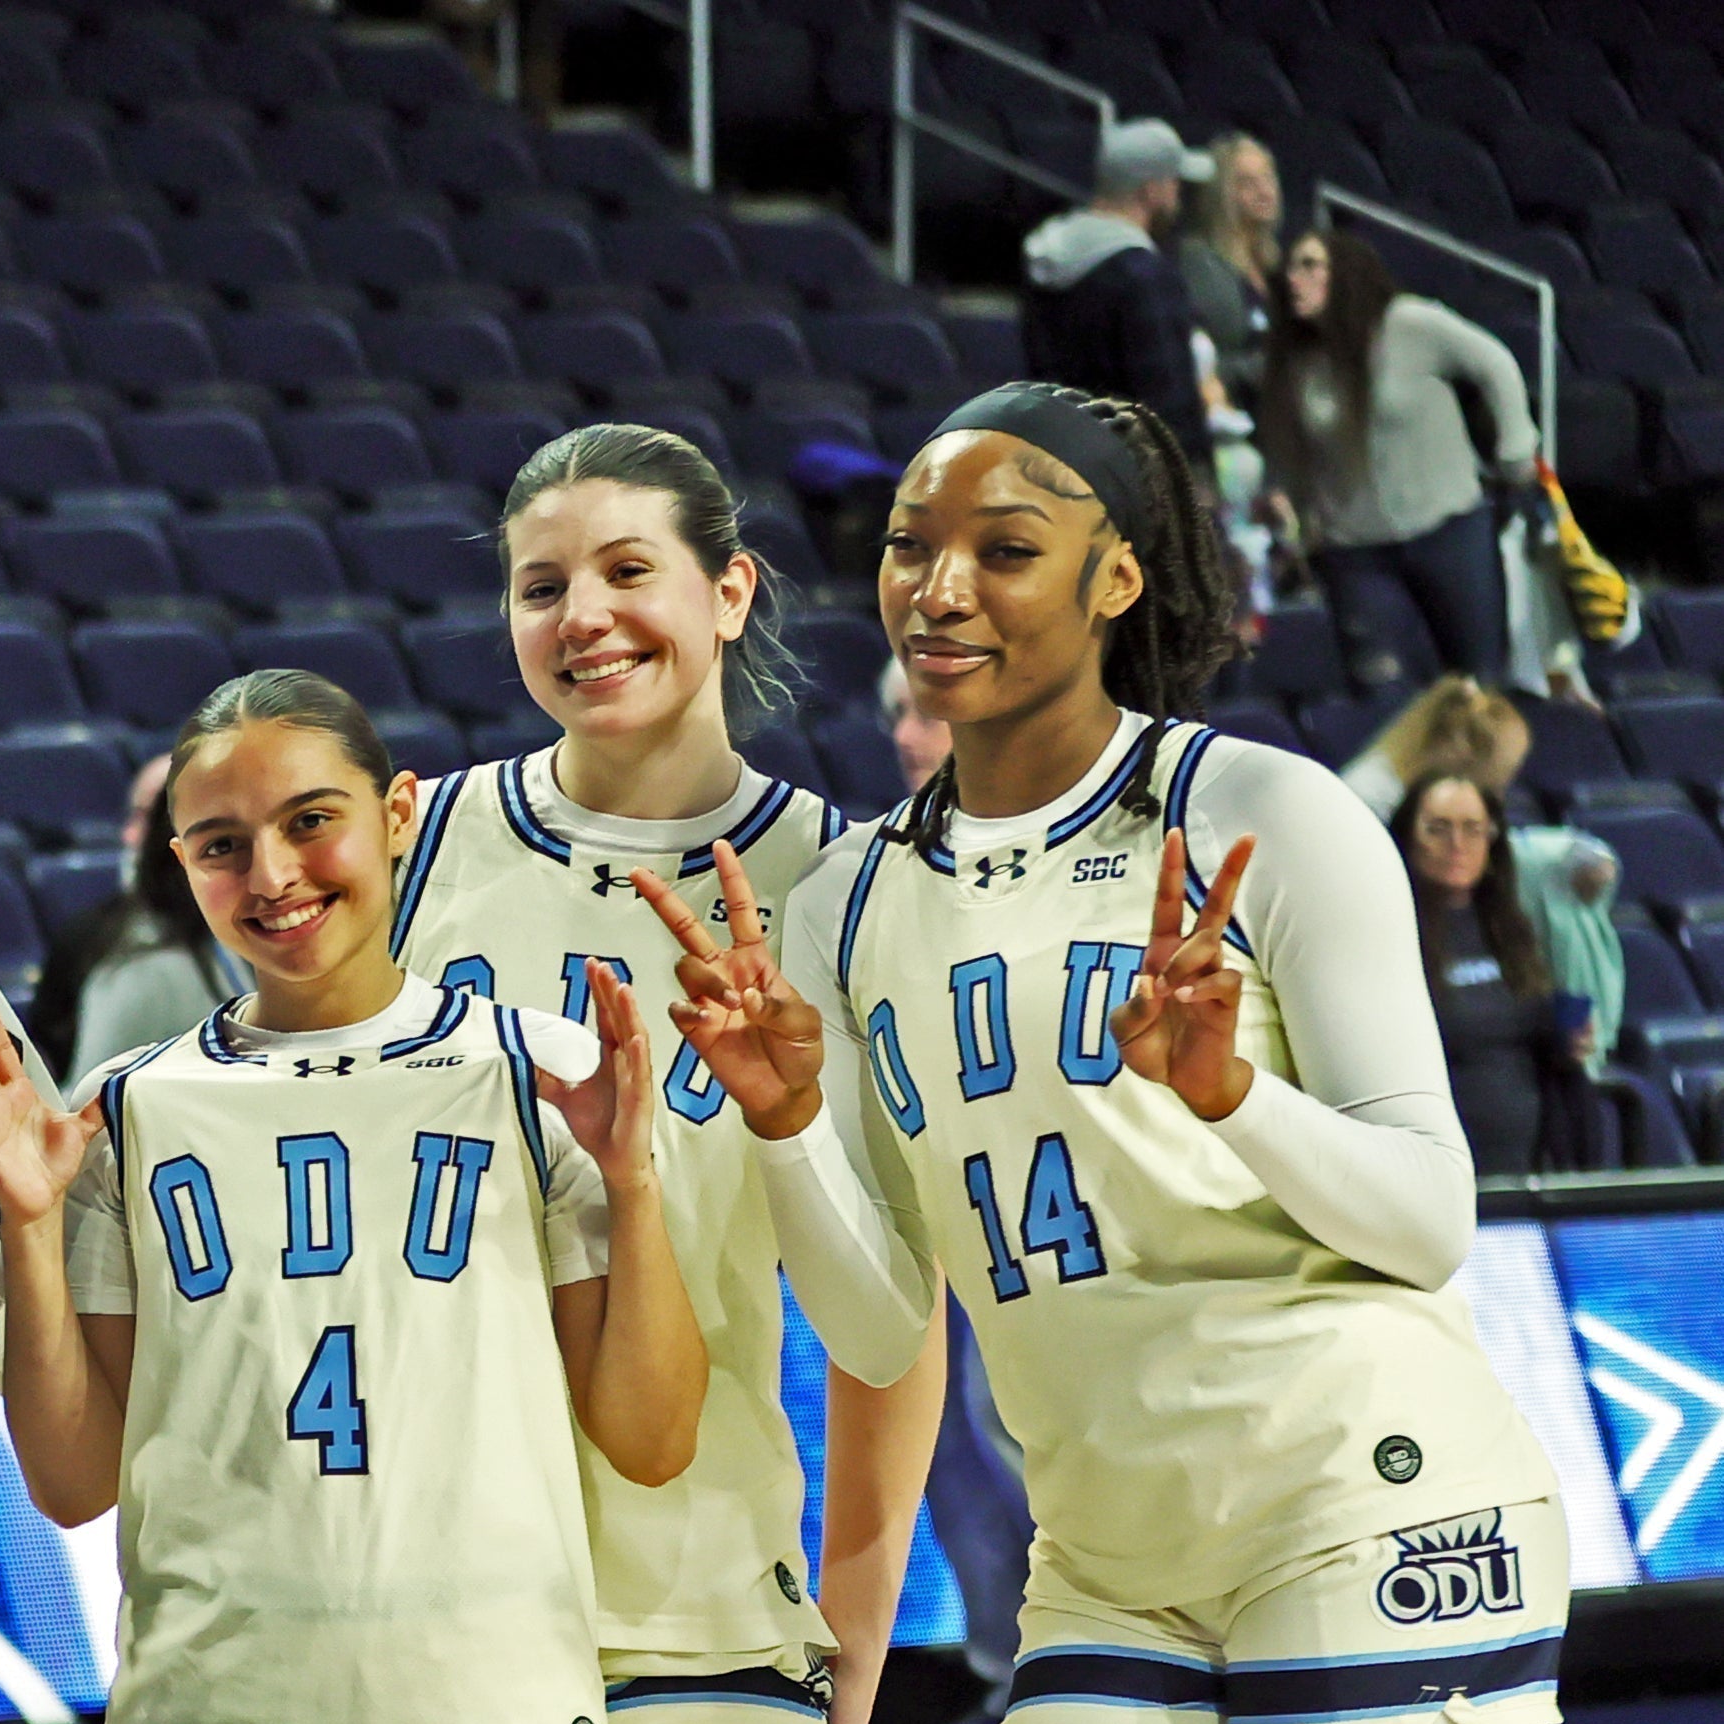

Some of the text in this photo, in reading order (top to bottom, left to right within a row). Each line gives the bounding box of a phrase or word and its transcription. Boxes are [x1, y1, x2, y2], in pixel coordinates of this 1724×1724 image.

[1073, 853, 1128, 883] SBC
[403, 1054, 465, 1071] SBC
[149, 1130, 495, 1303] ODU
[963, 1132, 1108, 1305] 14
[287, 1325, 369, 1476] 4
[1377, 1546, 1524, 1625] ODU
